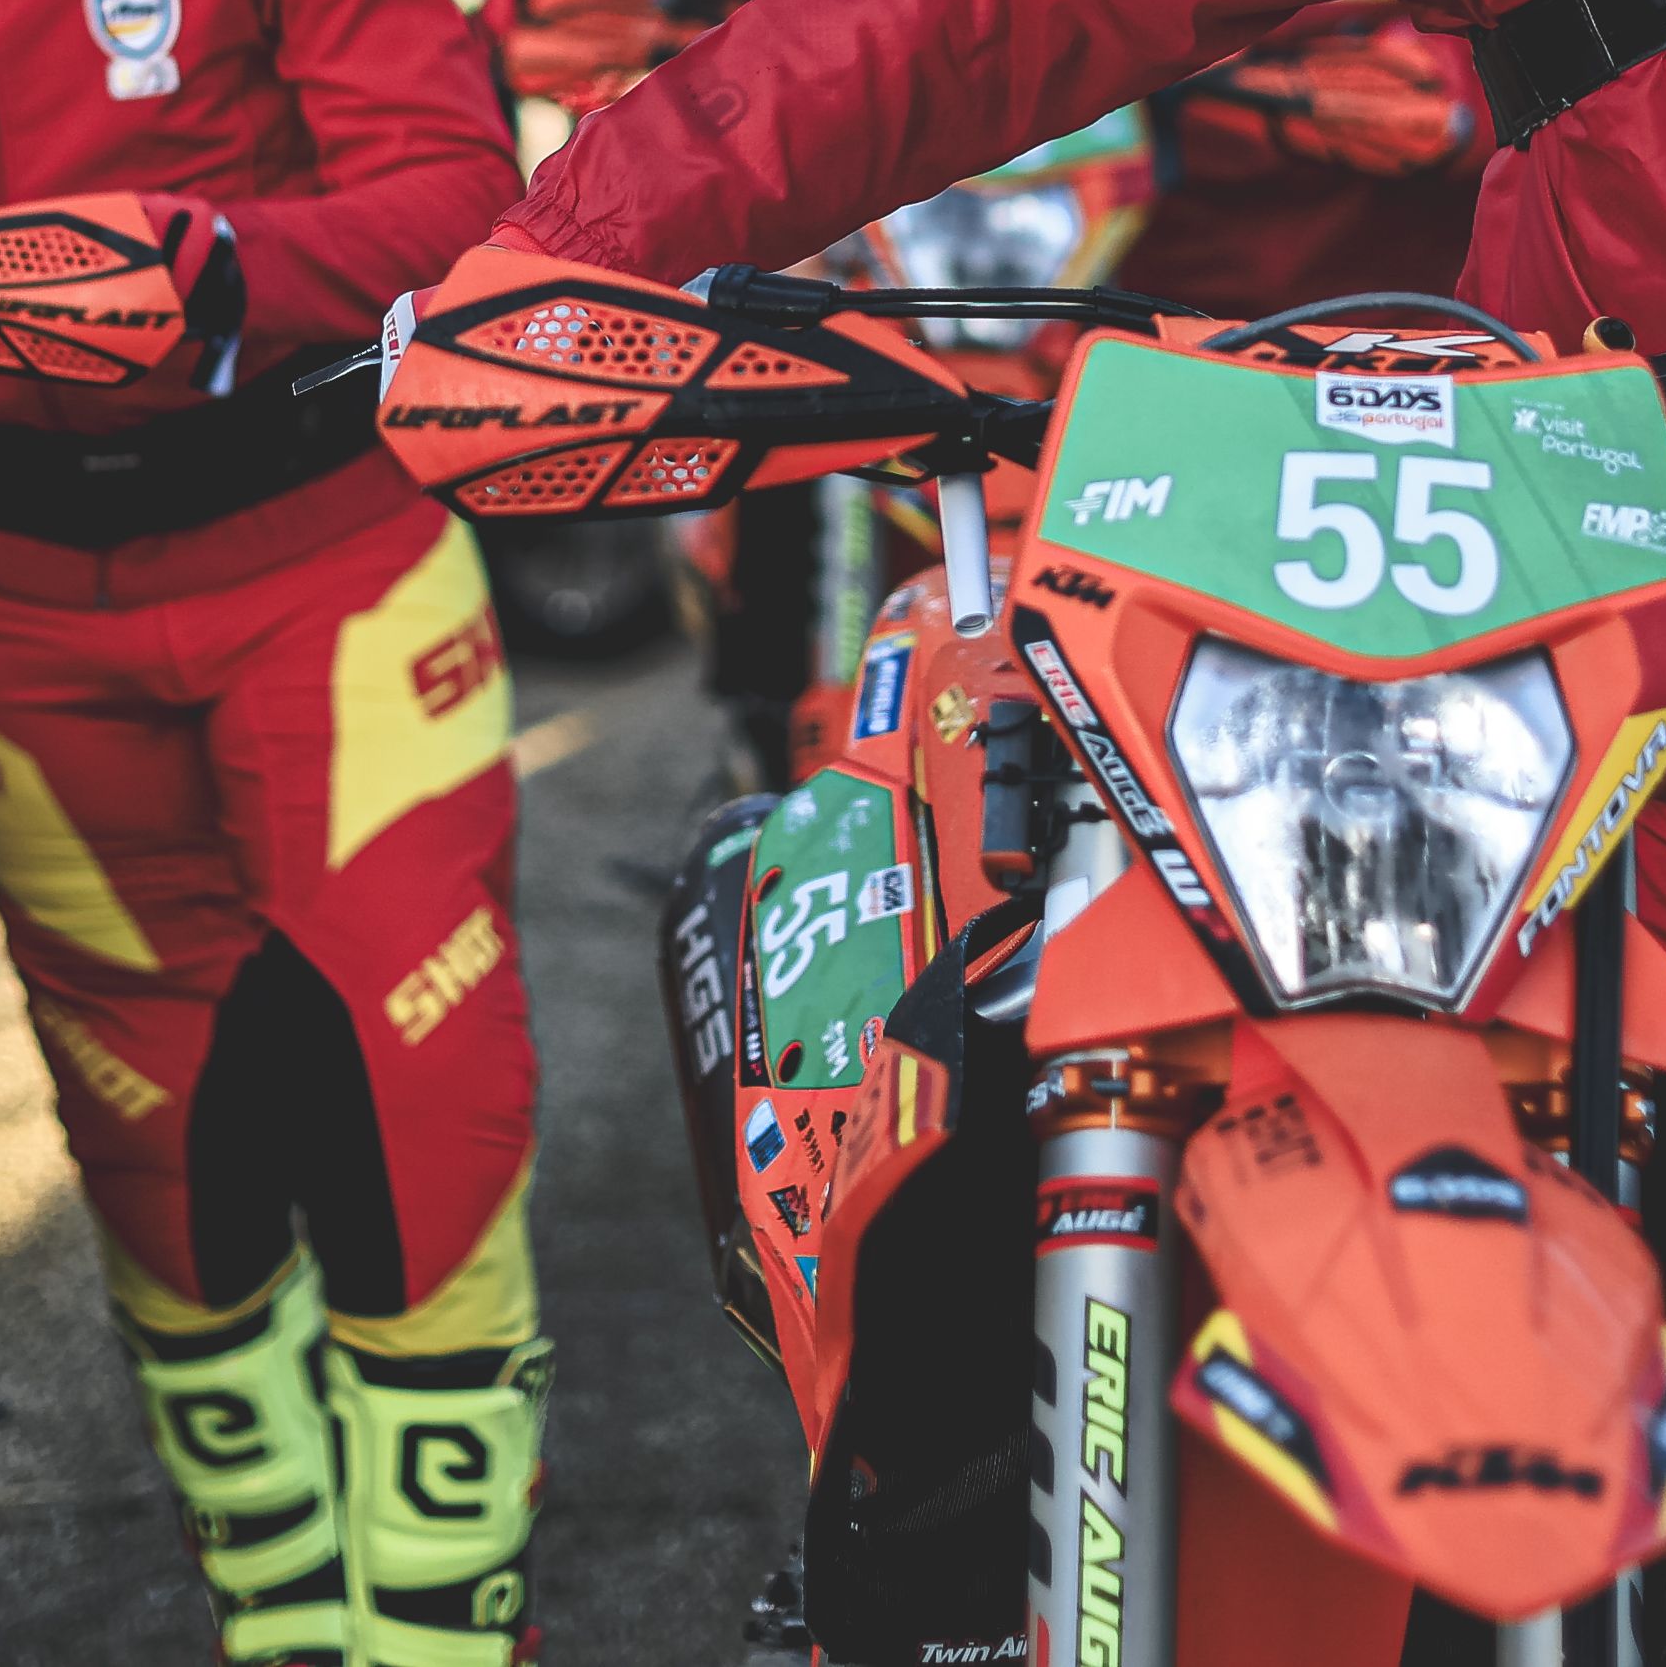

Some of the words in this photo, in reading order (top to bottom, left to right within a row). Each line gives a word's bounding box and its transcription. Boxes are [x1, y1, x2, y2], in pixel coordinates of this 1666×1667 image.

[1065, 475, 1172, 525] FIM
[1274, 451, 1500, 617] 55
[1033, 565, 1116, 609] KTM
[676, 902, 733, 1076] HGS
[762, 870, 850, 1001] 55
[1078, 1296, 1131, 1494] ERIC
[921, 1641, 990, 1664] Twin
